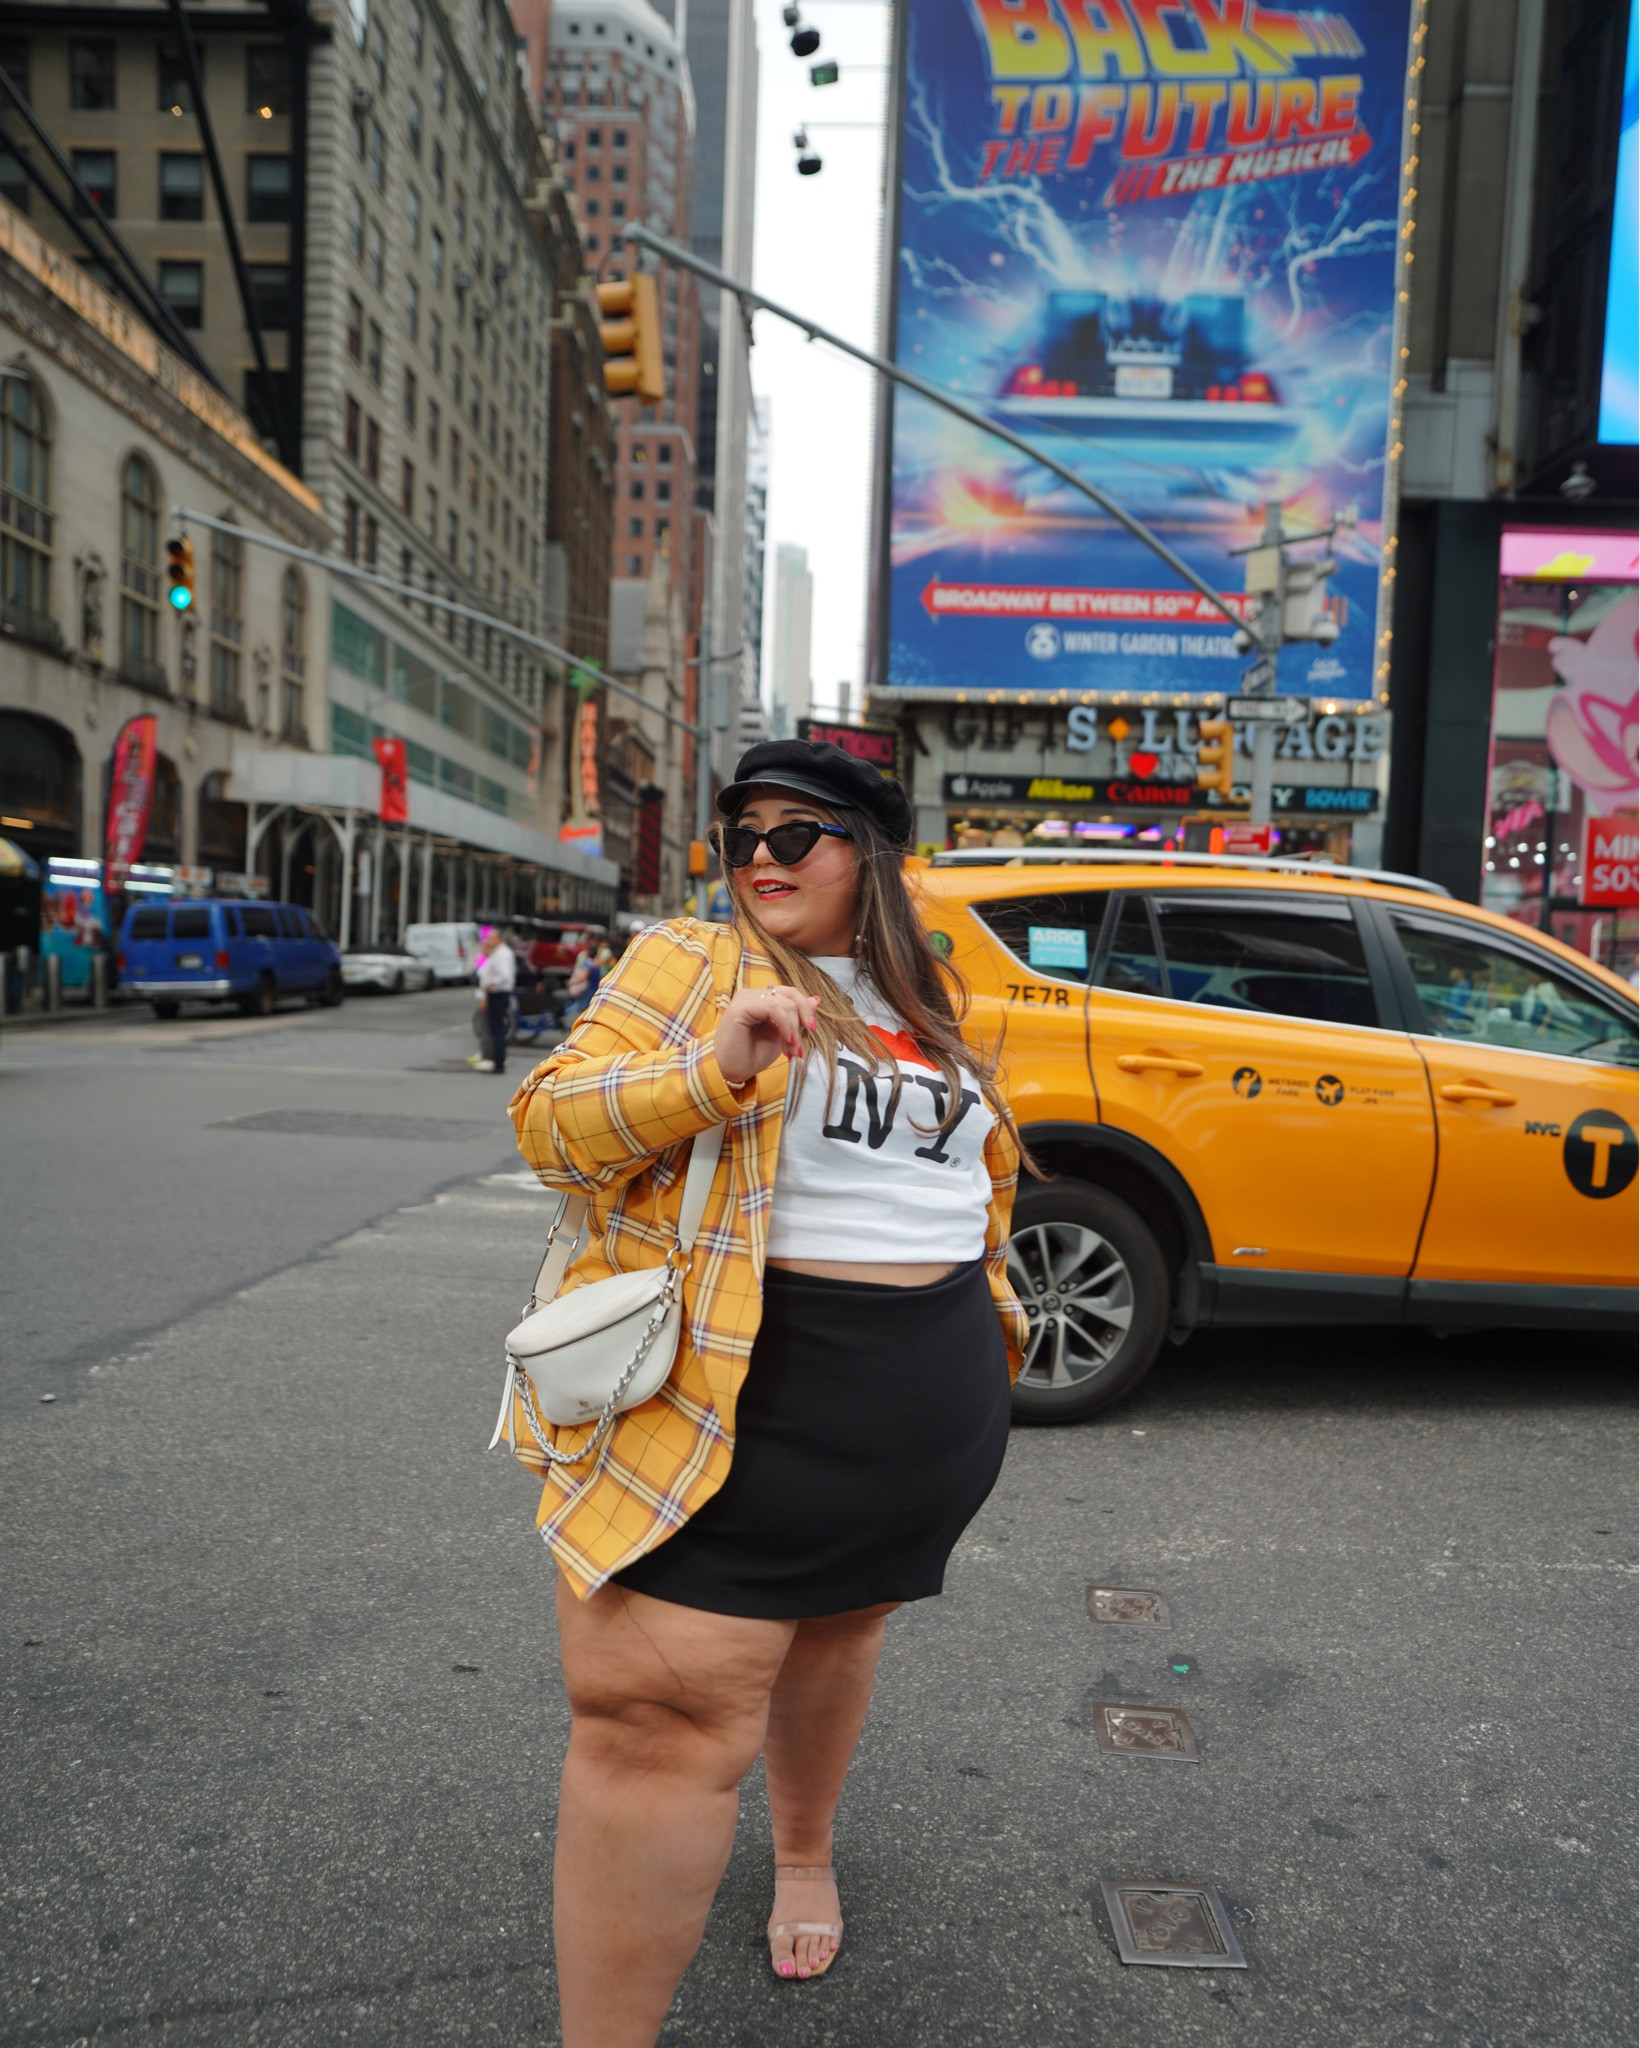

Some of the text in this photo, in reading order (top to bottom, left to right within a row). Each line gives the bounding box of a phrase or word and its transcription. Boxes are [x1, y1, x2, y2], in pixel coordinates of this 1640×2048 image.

[978, 0, 1318, 79] BACK
[991, 74, 1363, 171] TO FUTURE
[980, 135, 1065, 179] THE
[1162, 137, 1354, 194] THE MUSICAL
[931, 587, 1048, 611] BROADWAY
[1049, 591, 1150, 614] BETWEEN
[1063, 630, 1118, 654] WINTER
[1120, 632, 1179, 656] GARDEN
[968, 779, 1013, 798] Apple
[1028, 778, 1094, 800] Nikon
[1107, 781, 1191, 805] Canon
[1305, 788, 1373, 810] BOWER
[1032, 928, 1085, 945] ARRO
[1006, 984, 1070, 1010] 7E78
[1268, 1077, 1310, 1088] METERED
[1276, 1088, 1299, 1097] FARE
[1350, 1086, 1395, 1098] FLAT FARE
[822, 1057, 981, 1164] NY
[1524, 1119, 1562, 1138] NYC
